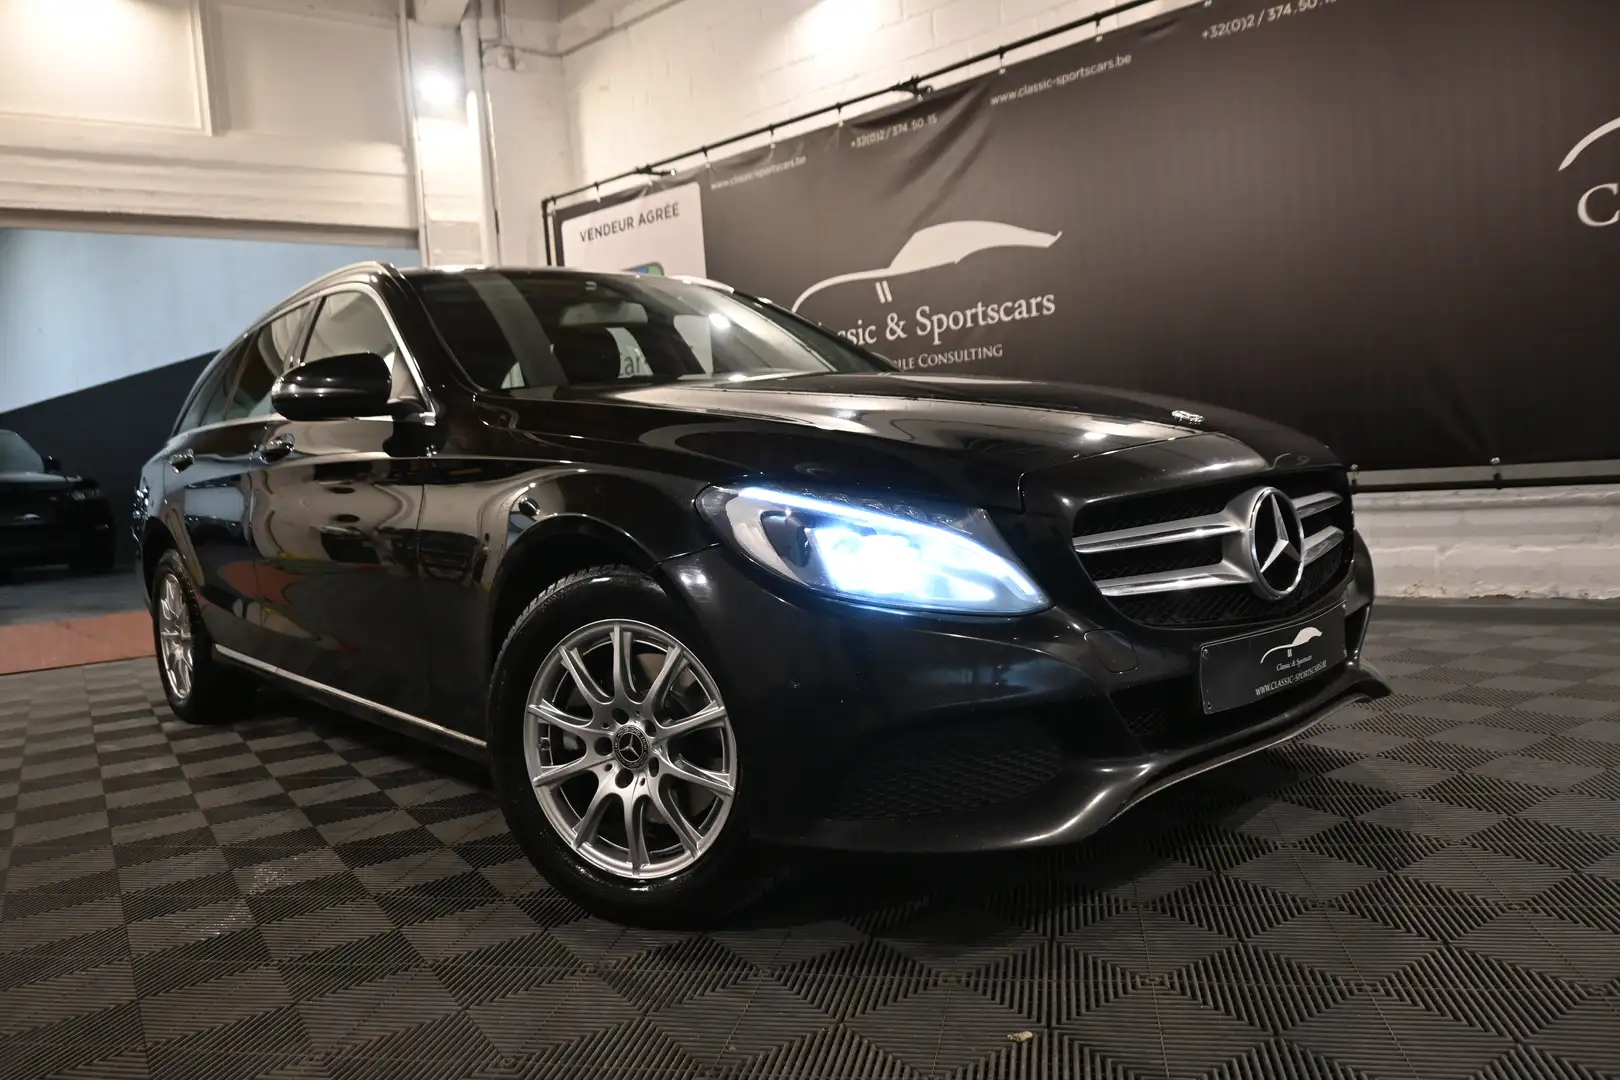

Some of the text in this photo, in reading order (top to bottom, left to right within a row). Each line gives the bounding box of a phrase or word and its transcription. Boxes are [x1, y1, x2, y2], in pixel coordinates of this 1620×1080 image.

[1266, 0, 1337, 22] 374.50.
[989, 53, 1132, 105] www.classic-sportscars.be
[579, 201, 680, 242] VENDEUR AGRÉE
[884, 312, 908, 341] &
[915, 292, 1056, 346] Sportscars
[917, 344, 1003, 368] CONSULTING
